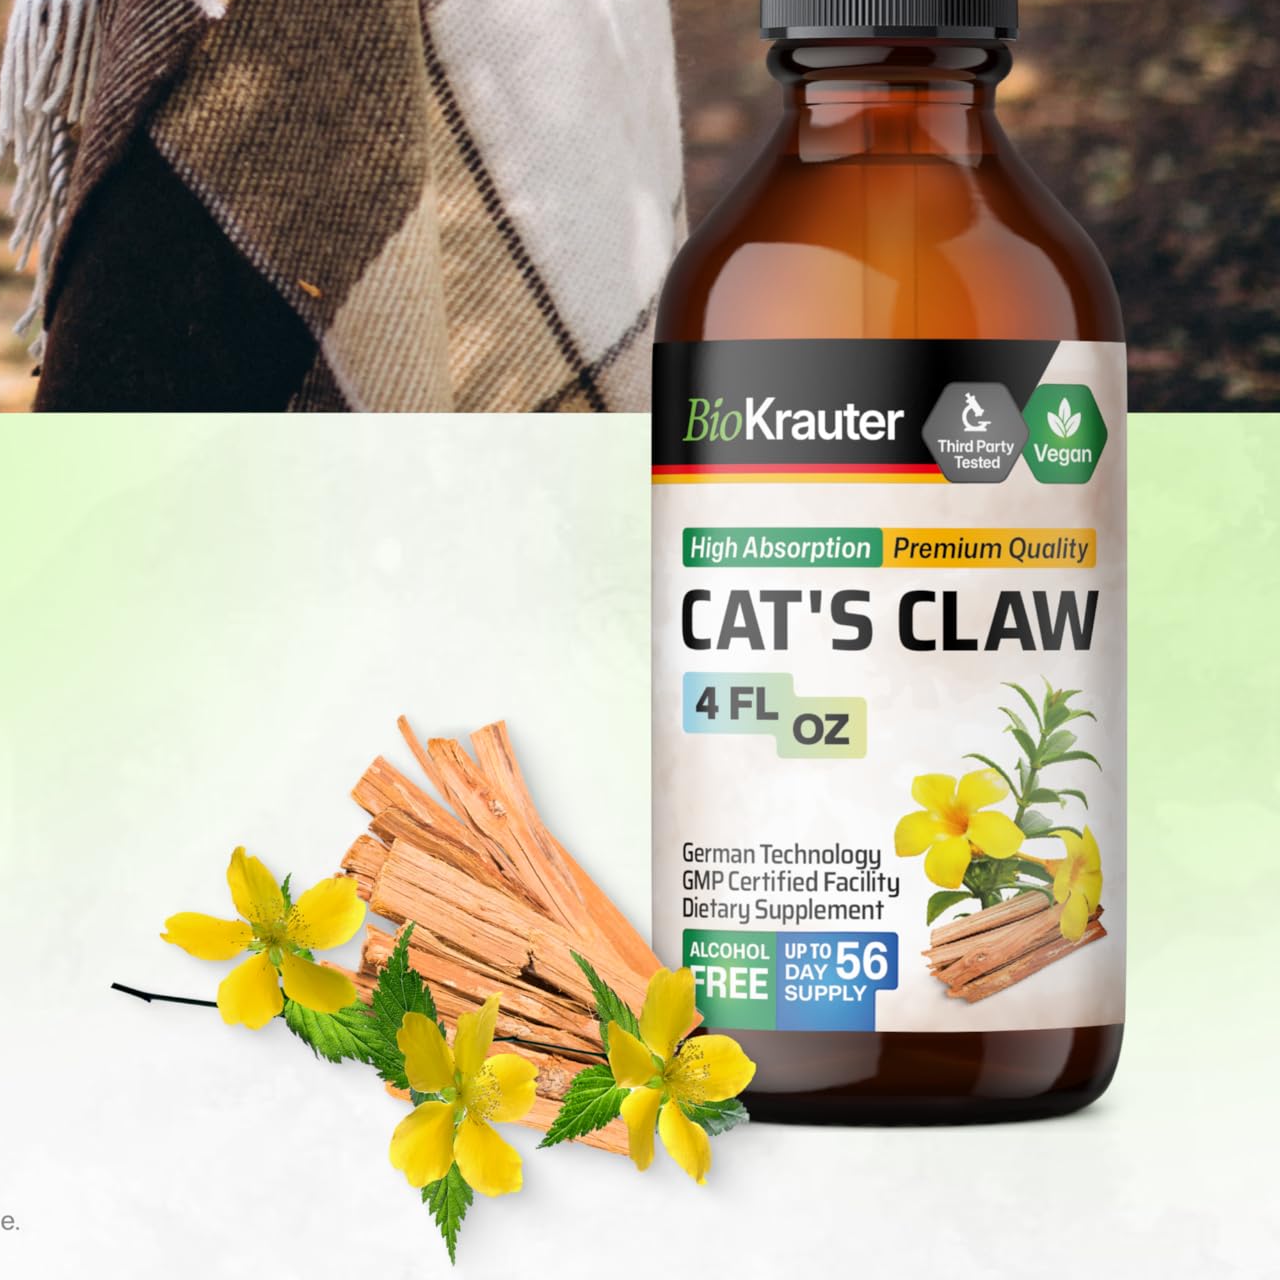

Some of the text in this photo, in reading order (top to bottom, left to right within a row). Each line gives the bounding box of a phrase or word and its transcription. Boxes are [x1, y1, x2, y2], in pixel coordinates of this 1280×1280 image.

[682, 396, 905, 443] BioKrauter
[937, 439, 1015, 456] Third Party
[1033, 443, 1093, 466] Vegan
[954, 455, 1001, 469] Tested
[690, 535, 871, 564] High Absorption
[894, 537, 1089, 564] Premium Quality
[681, 588, 1100, 652] CAT'S CLAW
[695, 686, 779, 720] 4 FL
[792, 713, 850, 745] OZ
[682, 842, 882, 870] German Technology
[682, 870, 900, 897] GMP Certified Facility
[682, 897, 885, 925] Dietary Supplement
[689, 941, 771, 960] ALCOHOL
[784, 940, 889, 981] UP TO 56
[784, 963, 828, 981] DAY
[784, 984, 867, 1002] SUPPLY
